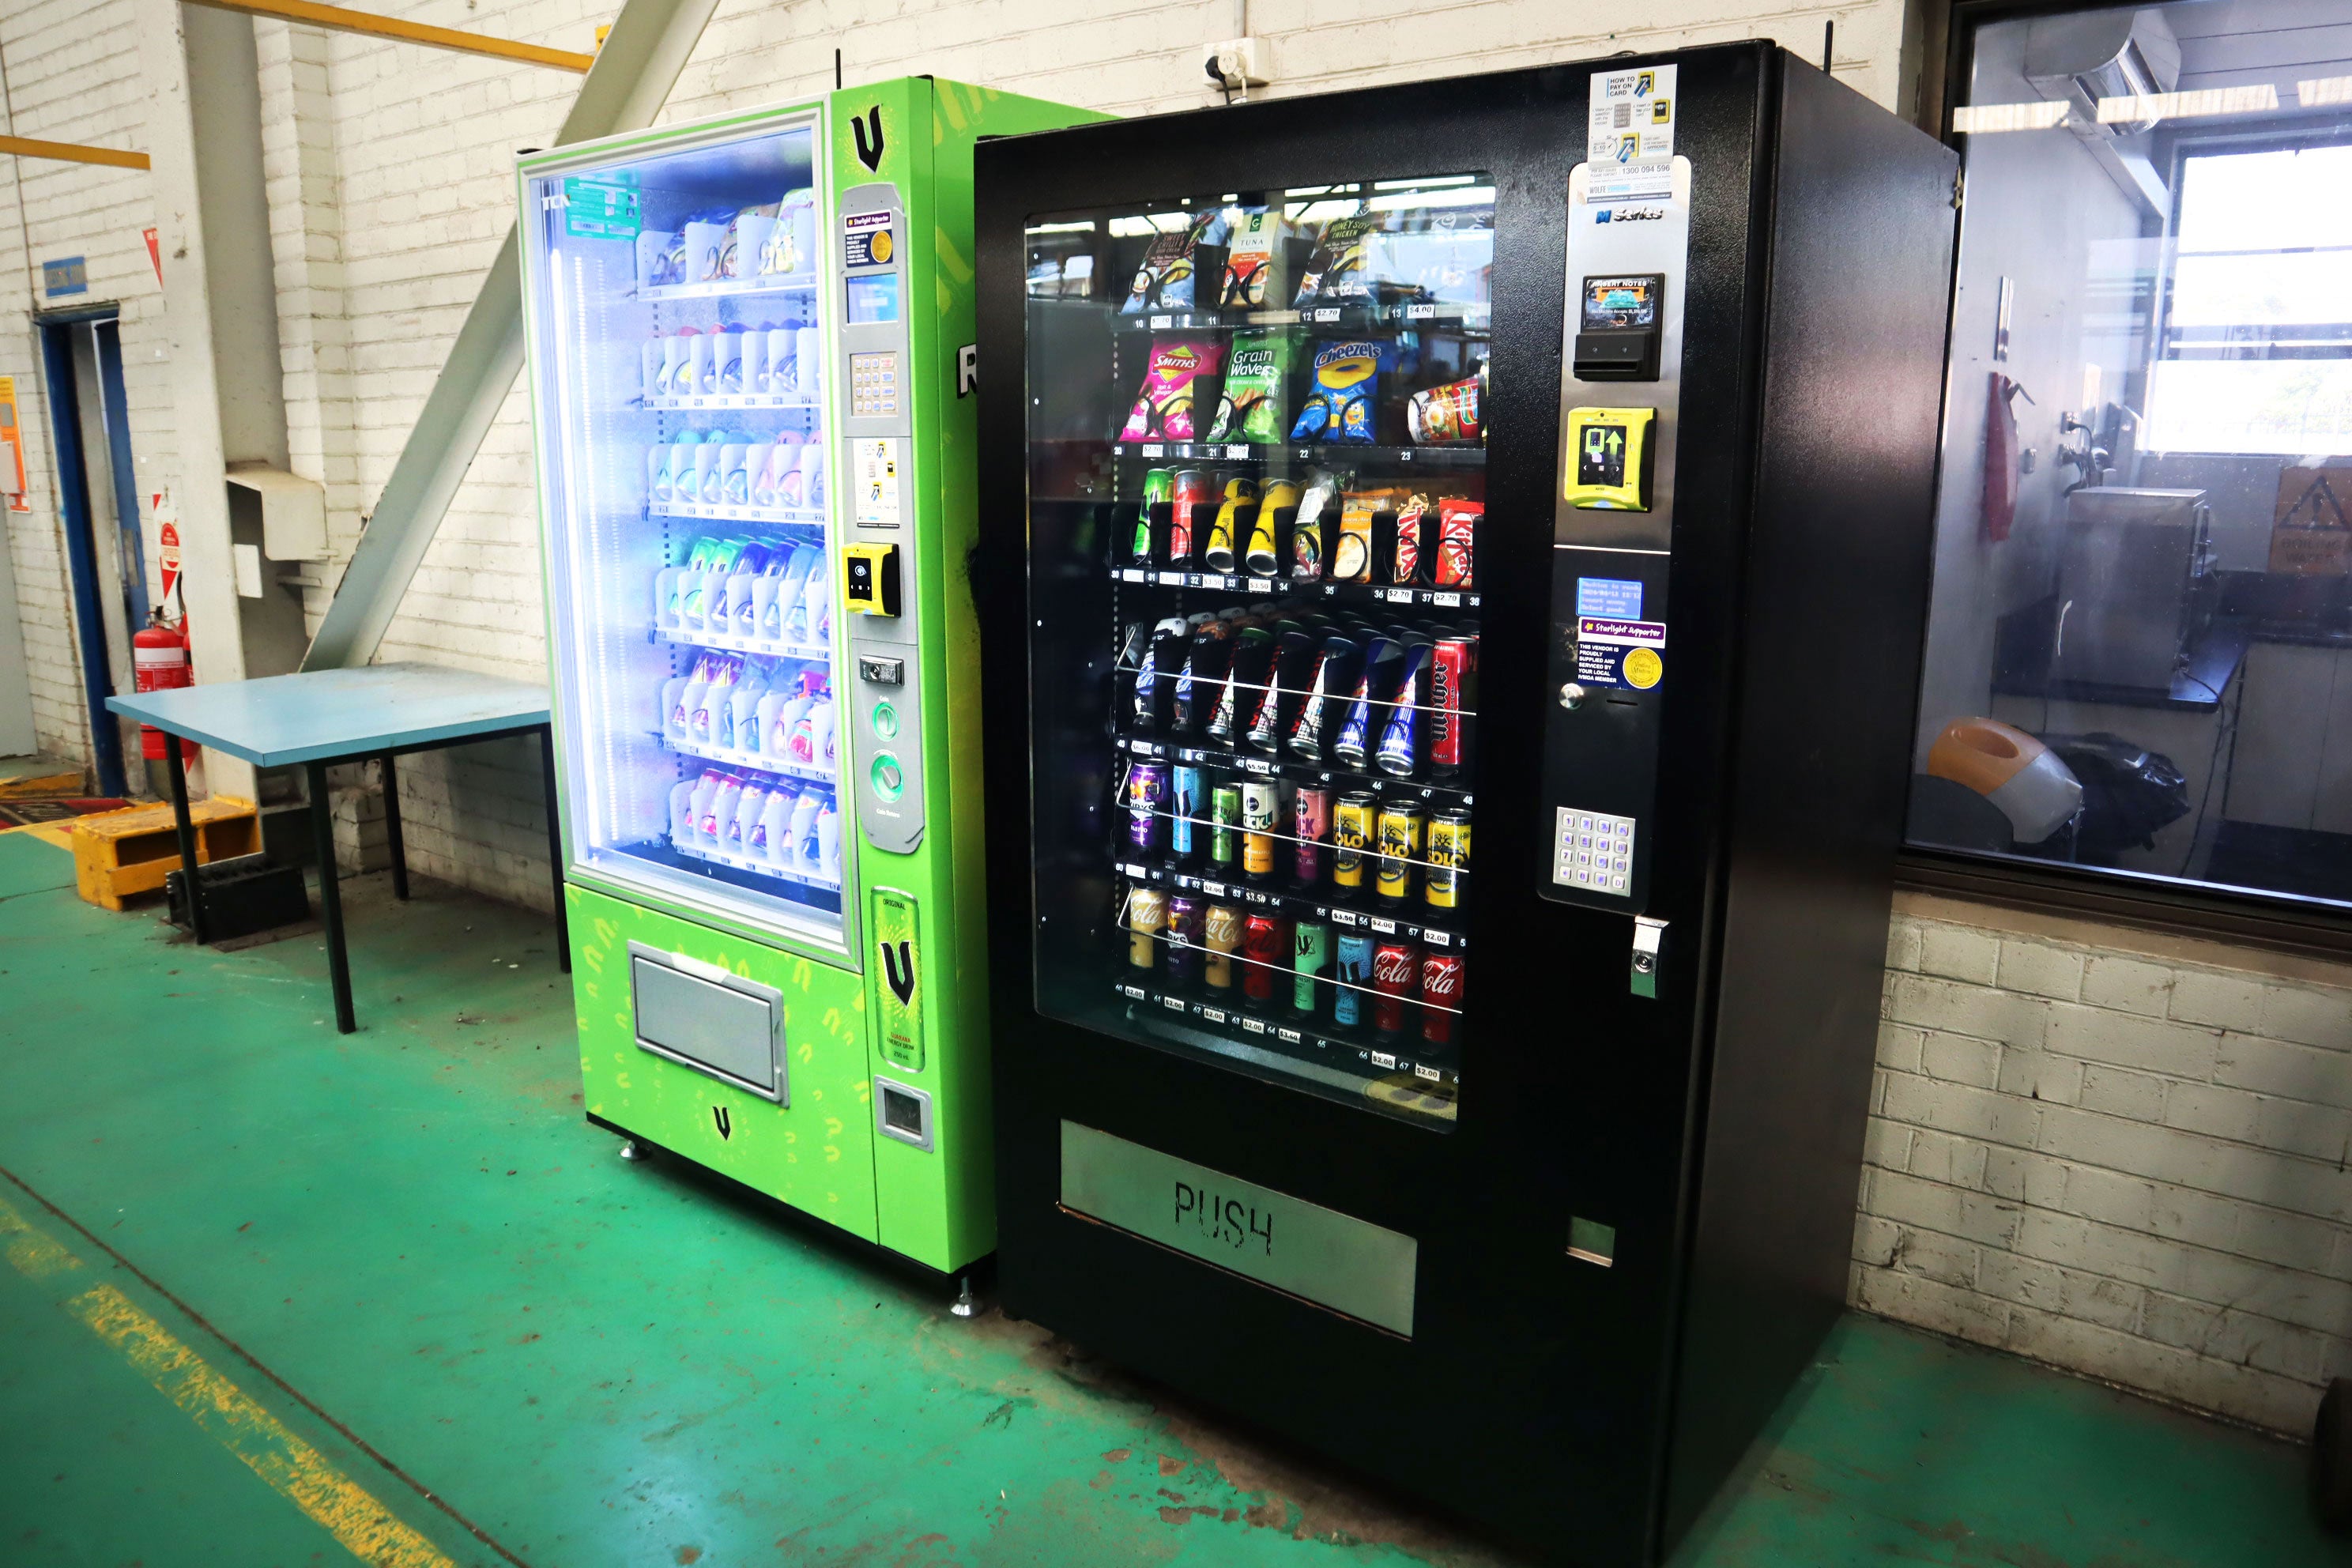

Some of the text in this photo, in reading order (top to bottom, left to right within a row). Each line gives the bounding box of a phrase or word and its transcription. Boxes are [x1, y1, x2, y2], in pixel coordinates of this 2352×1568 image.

[1589, 185, 1606, 194] WOLFE
[1614, 205, 1663, 221] Series
[1353, 221, 1370, 230] SOY
[1332, 229, 1358, 239] CHICKEN
[1208, 316, 1216, 325] 11
[1302, 313, 1311, 322] 12
[1392, 309, 1401, 318] 13
[1154, 355, 1197, 368] SMITH'S
[1234, 350, 1272, 364] Grain
[1315, 341, 1381, 368] Cheezels
[1401, 452, 1411, 461] 23
[1216, 533, 1226, 546] Red
[1397, 507, 1422, 575] TWIX
[1190, 576, 1199, 585] 32
[1280, 582, 1288, 591] 34
[1423, 594, 1431, 602] 37
[1596, 623, 1628, 635] Starlight
[1272, 765, 1280, 774] 44
[1372, 782, 1381, 790] 46
[1421, 789, 1431, 797] 47
[1463, 796, 1472, 805] 48
[1427, 848, 1464, 868] SOLO
[882, 898, 906, 910] ORIGINAL
[1204, 884, 1222, 893] $2.00
[1246, 890, 1266, 903] $3.50
[1317, 908, 1325, 917] 55
[1359, 917, 1368, 925] 56
[1373, 919, 1393, 928] $2.00
[1408, 928, 1418, 937] 57
[1426, 933, 1446, 943] $2.00
[880, 940, 914, 1008] V
[1374, 951, 1415, 983] Cola
[890, 1031, 910, 1043] GUARANA
[1127, 989, 1142, 997] $2.00
[1166, 1000, 1182, 1009] $2.00
[1205, 1010, 1223, 1020] $2.00
[1232, 1016, 1239, 1025] 63
[1245, 1021, 1262, 1031] $2.00
[1268, 1026, 1276, 1035] 64
[1280, 1031, 1298, 1041] $3.50
[1317, 1040, 1326, 1049] 65
[1359, 1051, 1368, 1060] 66
[1373, 1055, 1393, 1066] $2.00
[1416, 1067, 1438, 1078] $2.00
[713, 1106, 731, 1141] V
[1175, 1181, 1272, 1257] PUSH
